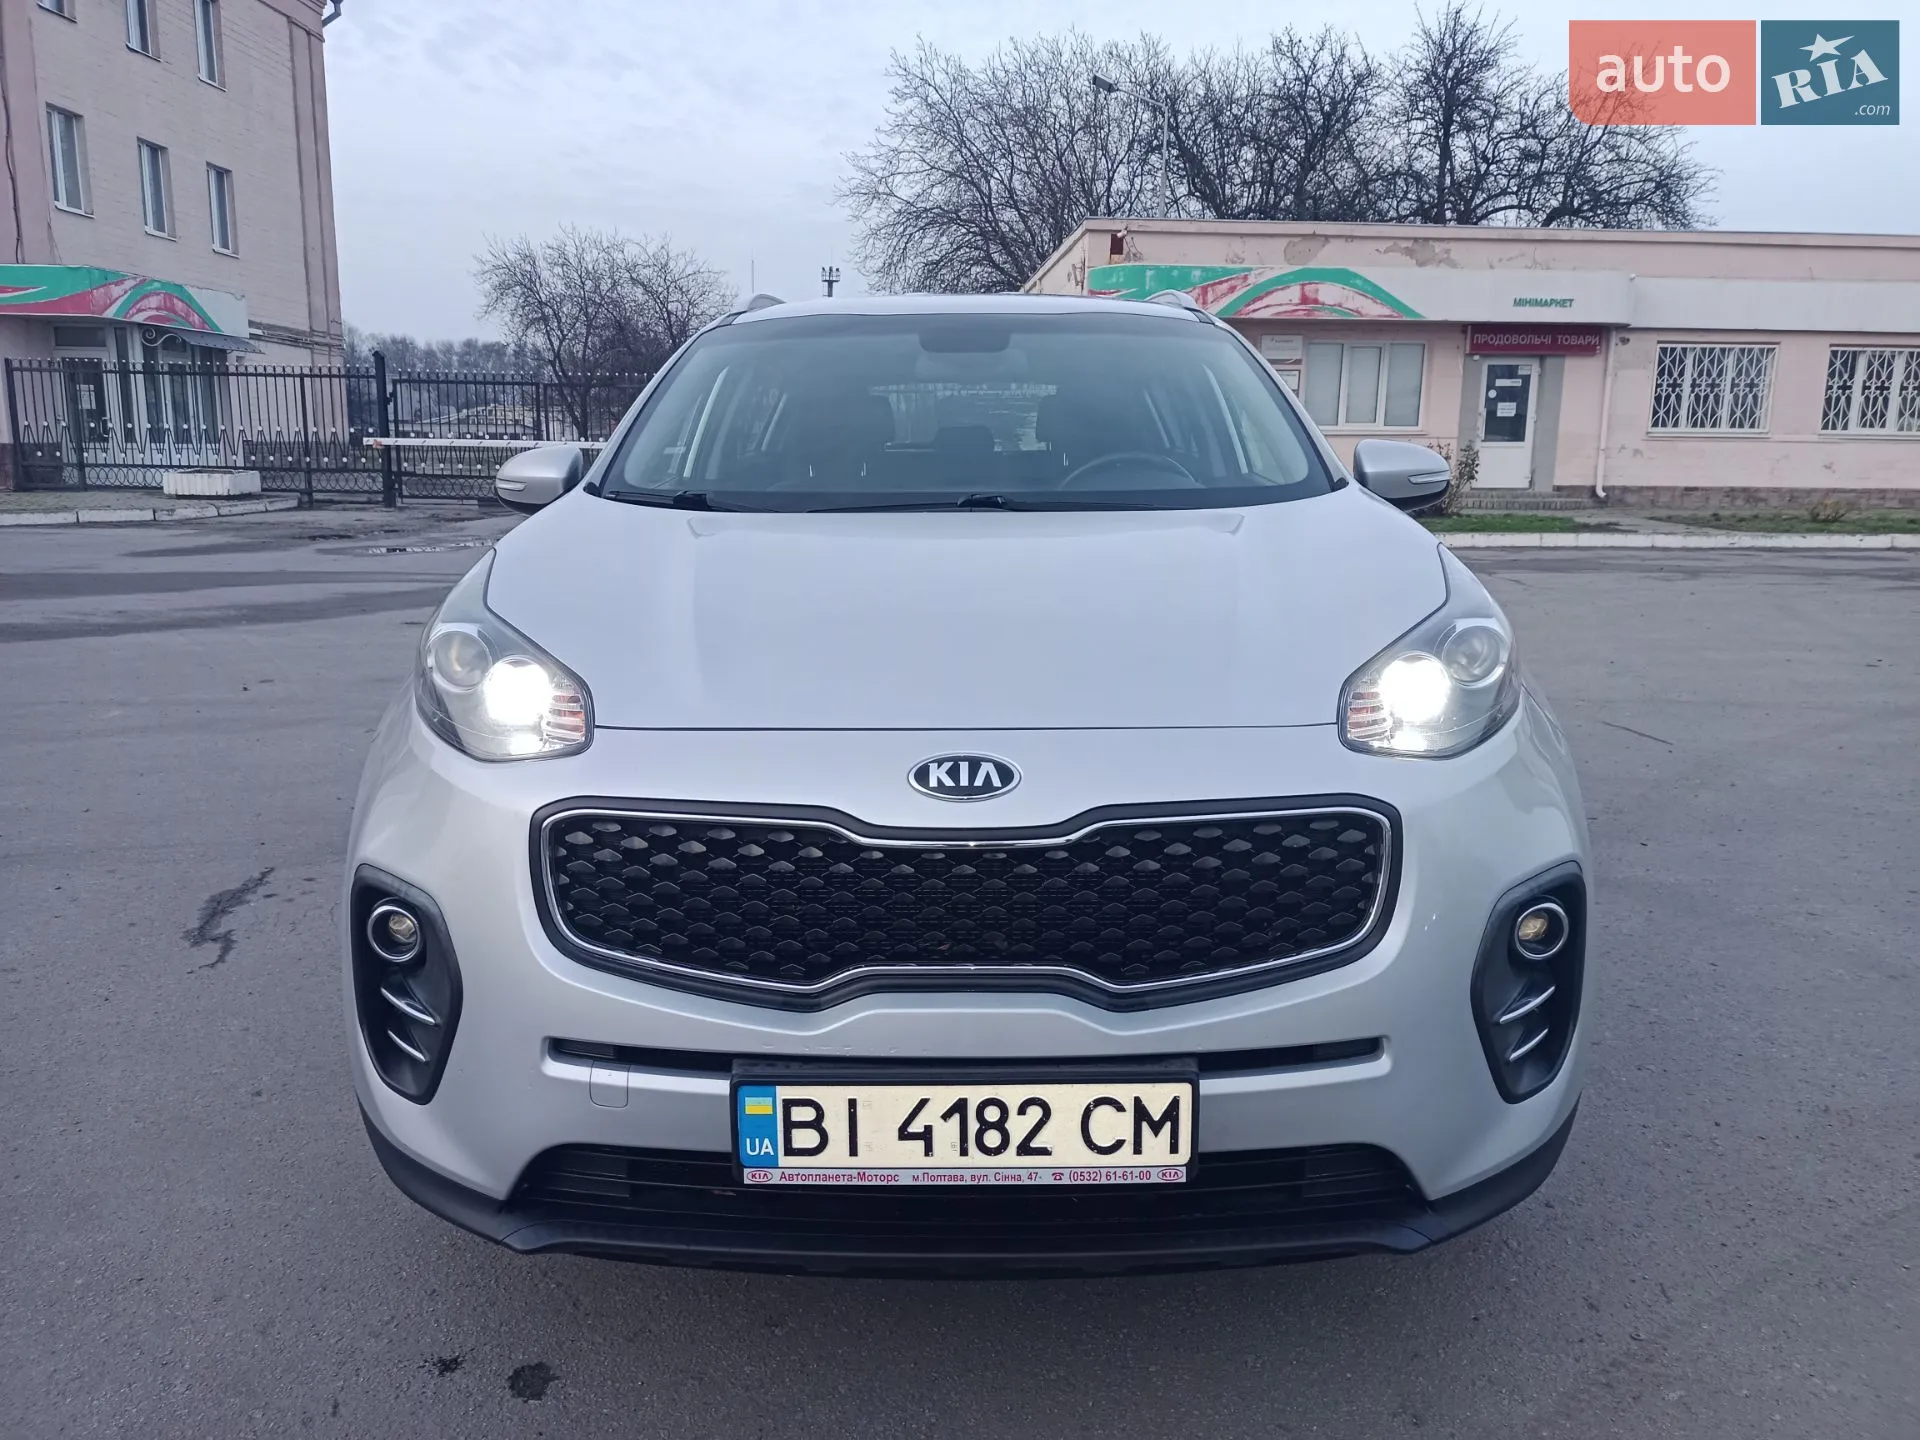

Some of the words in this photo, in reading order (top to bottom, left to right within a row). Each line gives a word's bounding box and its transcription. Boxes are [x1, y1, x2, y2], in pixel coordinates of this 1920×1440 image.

[1512, 297, 1575, 308] МІНІМАРКЕТ
[1473, 333, 1552, 346] ПРОДОВОЛЬЧІ
[1556, 334, 1600, 346] ТОВАРИ
[928, 761, 1002, 787] KIA
[782, 1098, 858, 1157] BI
[897, 1097, 1053, 1157] 4182
[1080, 1096, 1180, 1156] CM
[746, 1138, 774, 1156] UA
[779, 1171, 900, 1183] Автопланета-Моторс
[970, 1175, 990, 1184] вул.
[993, 1172, 1024, 1183] Сінна,
[1068, 1170, 1102, 1182] (0532)
[1105, 1170, 1151, 1181] 61-61-00
